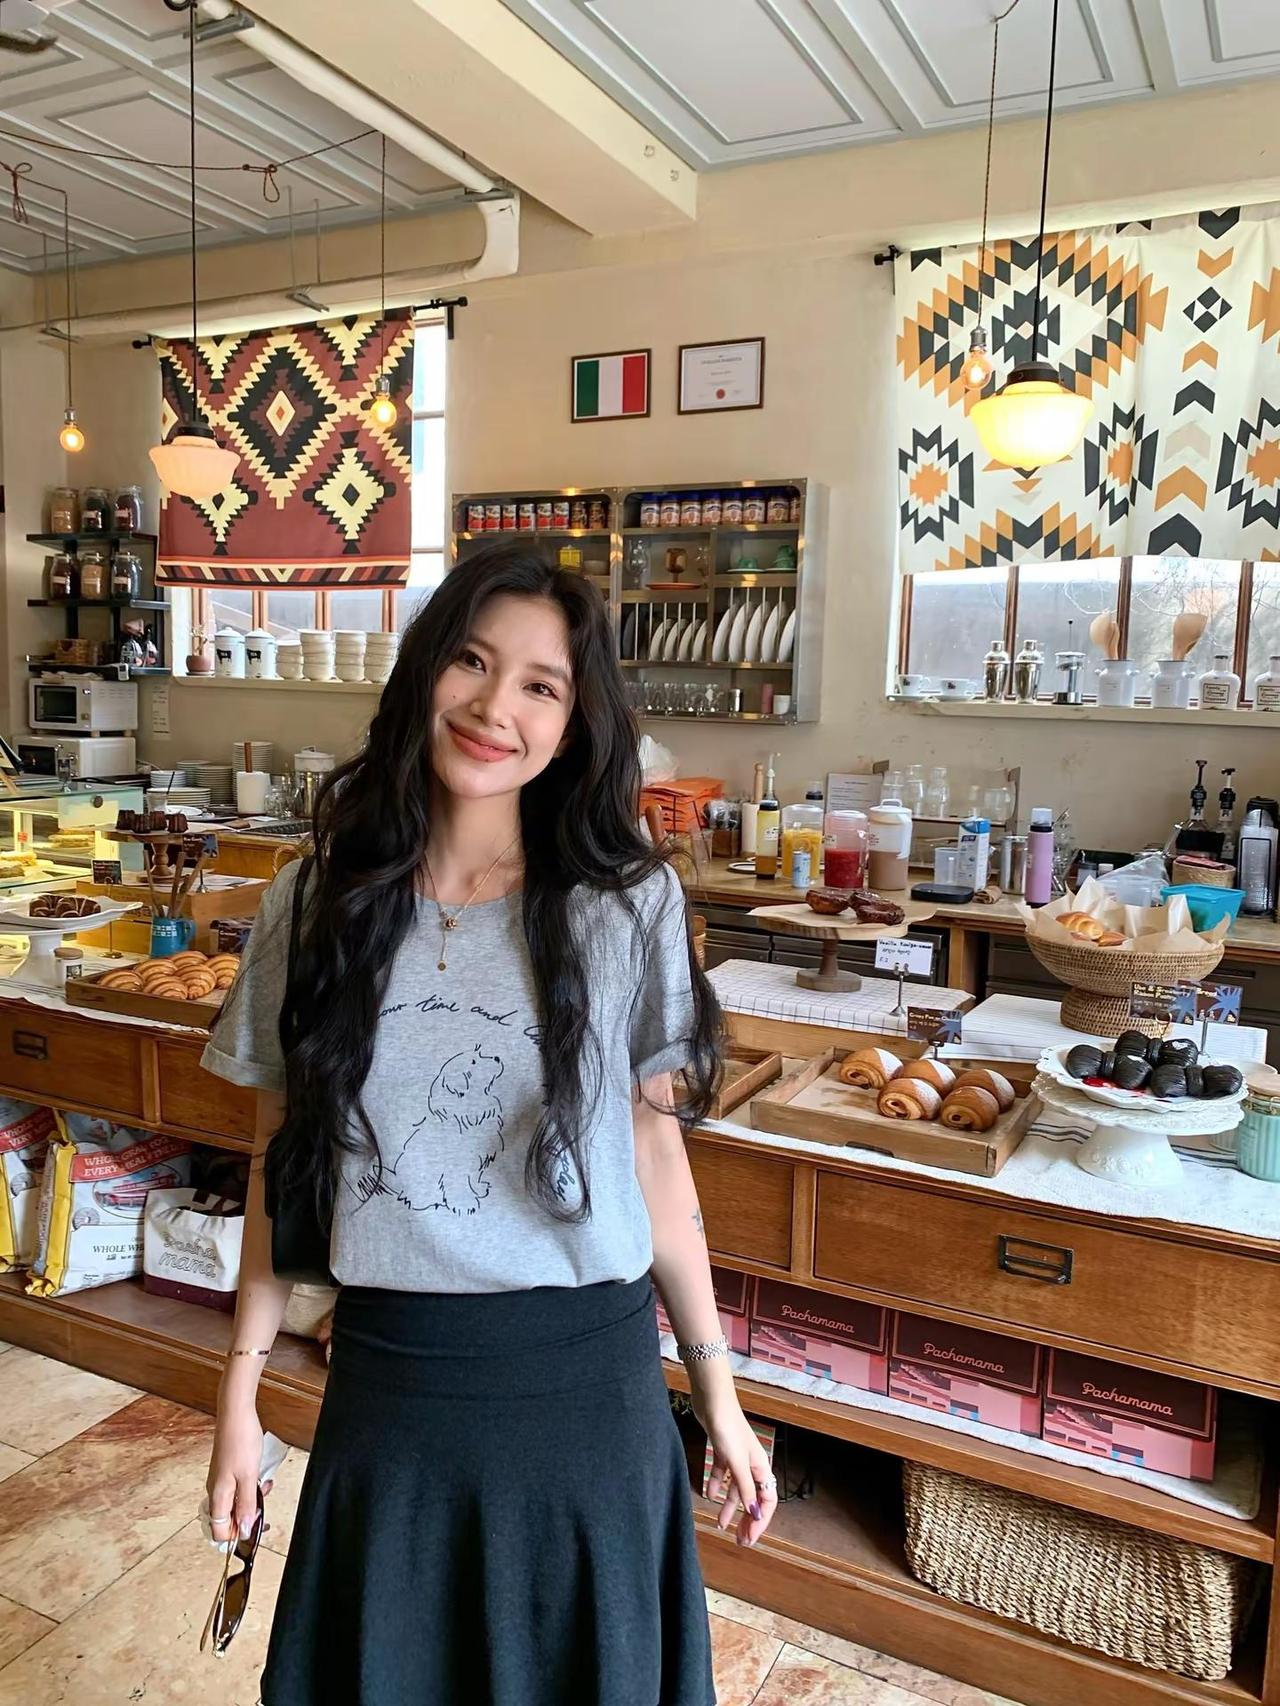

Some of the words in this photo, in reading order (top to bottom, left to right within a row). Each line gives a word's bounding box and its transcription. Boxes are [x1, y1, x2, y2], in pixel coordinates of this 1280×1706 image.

[415, 994, 461, 1013] time
[470, 1006, 519, 1026] and
[84, 1154, 120, 1167] WHO
[84, 1164, 119, 1177] EVERY
[92, 1244, 126, 1253] WHOLE
[781, 1304, 855, 1334] Pachamama
[923, 1342, 1005, 1373] Pachamama
[1081, 1382, 1174, 1416] Pachamama
